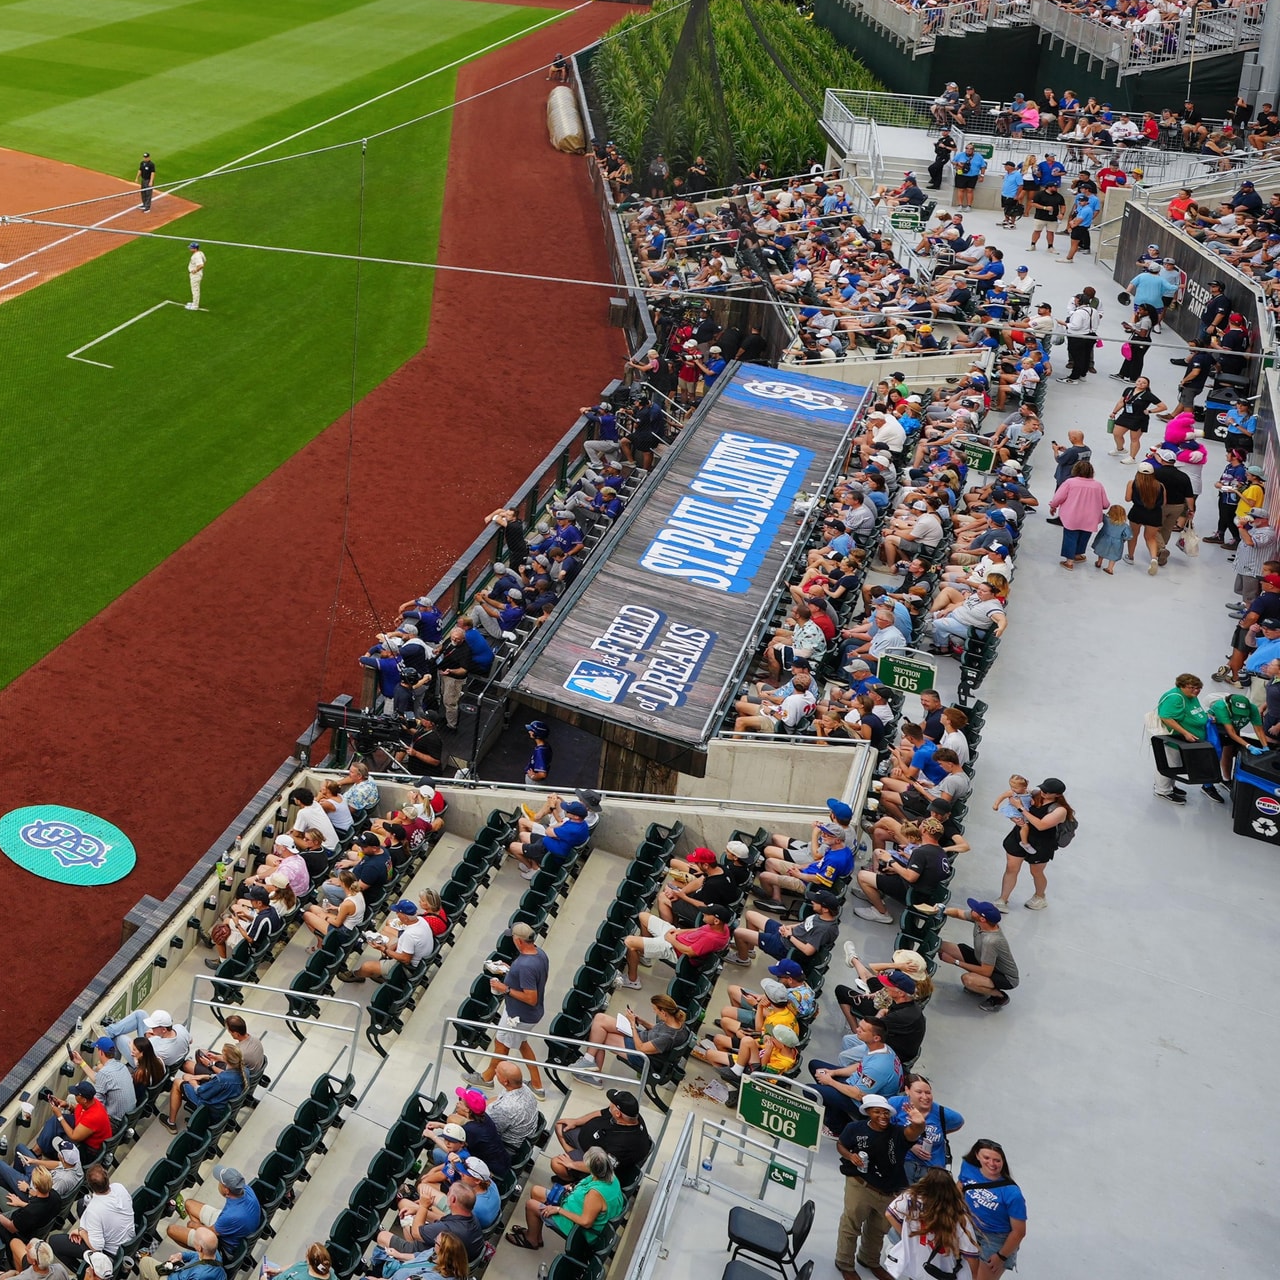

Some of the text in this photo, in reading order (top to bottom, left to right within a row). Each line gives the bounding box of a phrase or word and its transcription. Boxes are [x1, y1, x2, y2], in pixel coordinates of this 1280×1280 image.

[690, 433, 800, 510] SAINTS
[657, 496, 769, 562] PAUL
[591, 605, 661, 662] FIELD
[628, 624, 711, 712] of DREAMS
[893, 666, 921, 678] SECTION
[893, 674, 918, 691] 105
[1257, 801, 1280, 811] PEPSI
[760, 1098, 801, 1121] SECTION
[764, 1090, 812, 1112] FIELD DREAMS
[760, 1110, 797, 1139] 106
